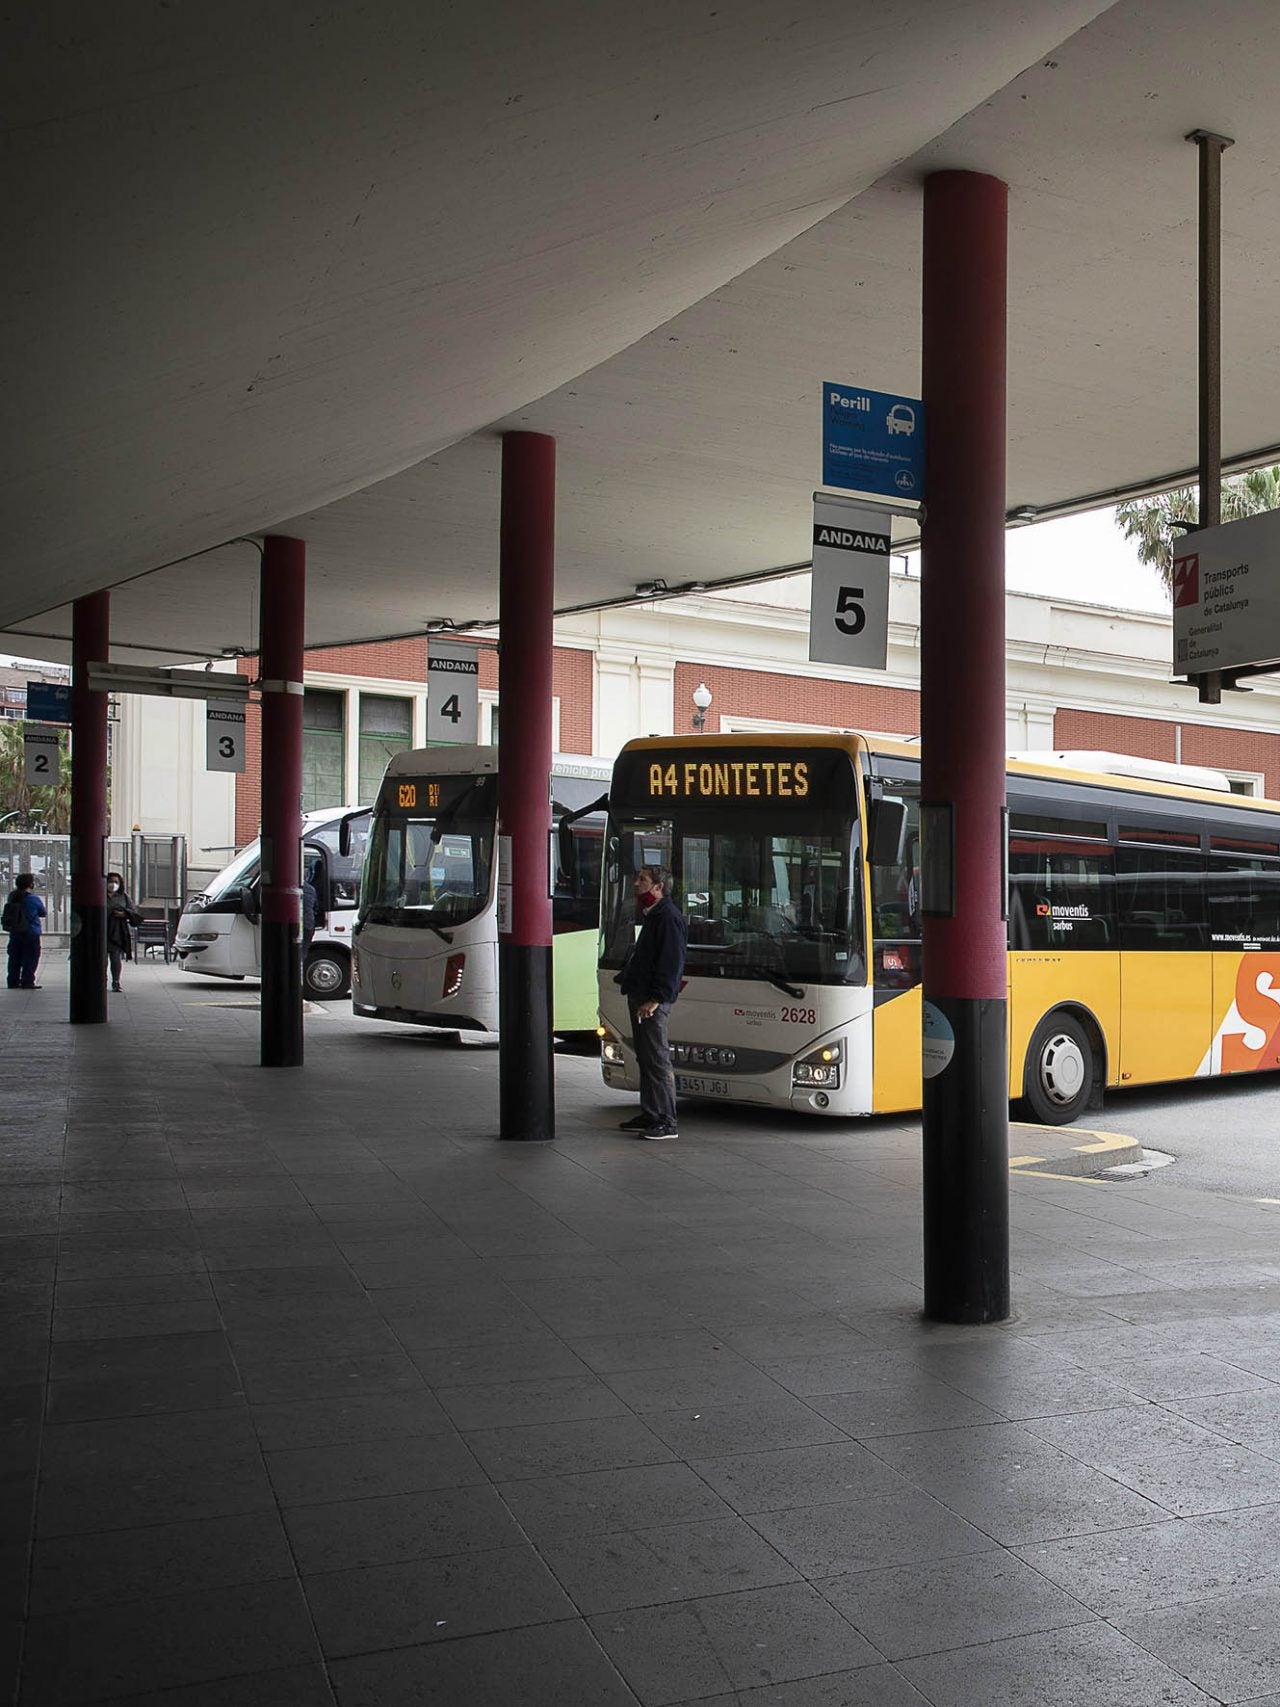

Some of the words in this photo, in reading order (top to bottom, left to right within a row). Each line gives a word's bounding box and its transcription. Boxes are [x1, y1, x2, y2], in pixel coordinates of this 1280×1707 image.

[830, 392, 871, 412] Perill
[819, 529, 887, 552] ANDANA
[1203, 563, 1249, 585] Transports
[1203, 584, 1235, 603] públics
[834, 586, 866, 635] 5
[1214, 598, 1249, 615] Catalunya
[431, 660, 477, 672] ANDANA
[208, 711, 245, 722] ANDANA
[440, 694, 461, 723] 4
[25, 735, 58, 744] ANDANA
[218, 736, 235, 758] 3
[34, 754, 49, 773] 2
[650, 763, 678, 796] A4
[684, 762, 809, 796] FONTETES
[398, 784, 417, 807] 620
[1051, 903, 1089, 917] moventis
[1053, 920, 1073, 931] sarbus
[781, 1006, 817, 1025] 2628
[681, 1078, 706, 1092] 3451
